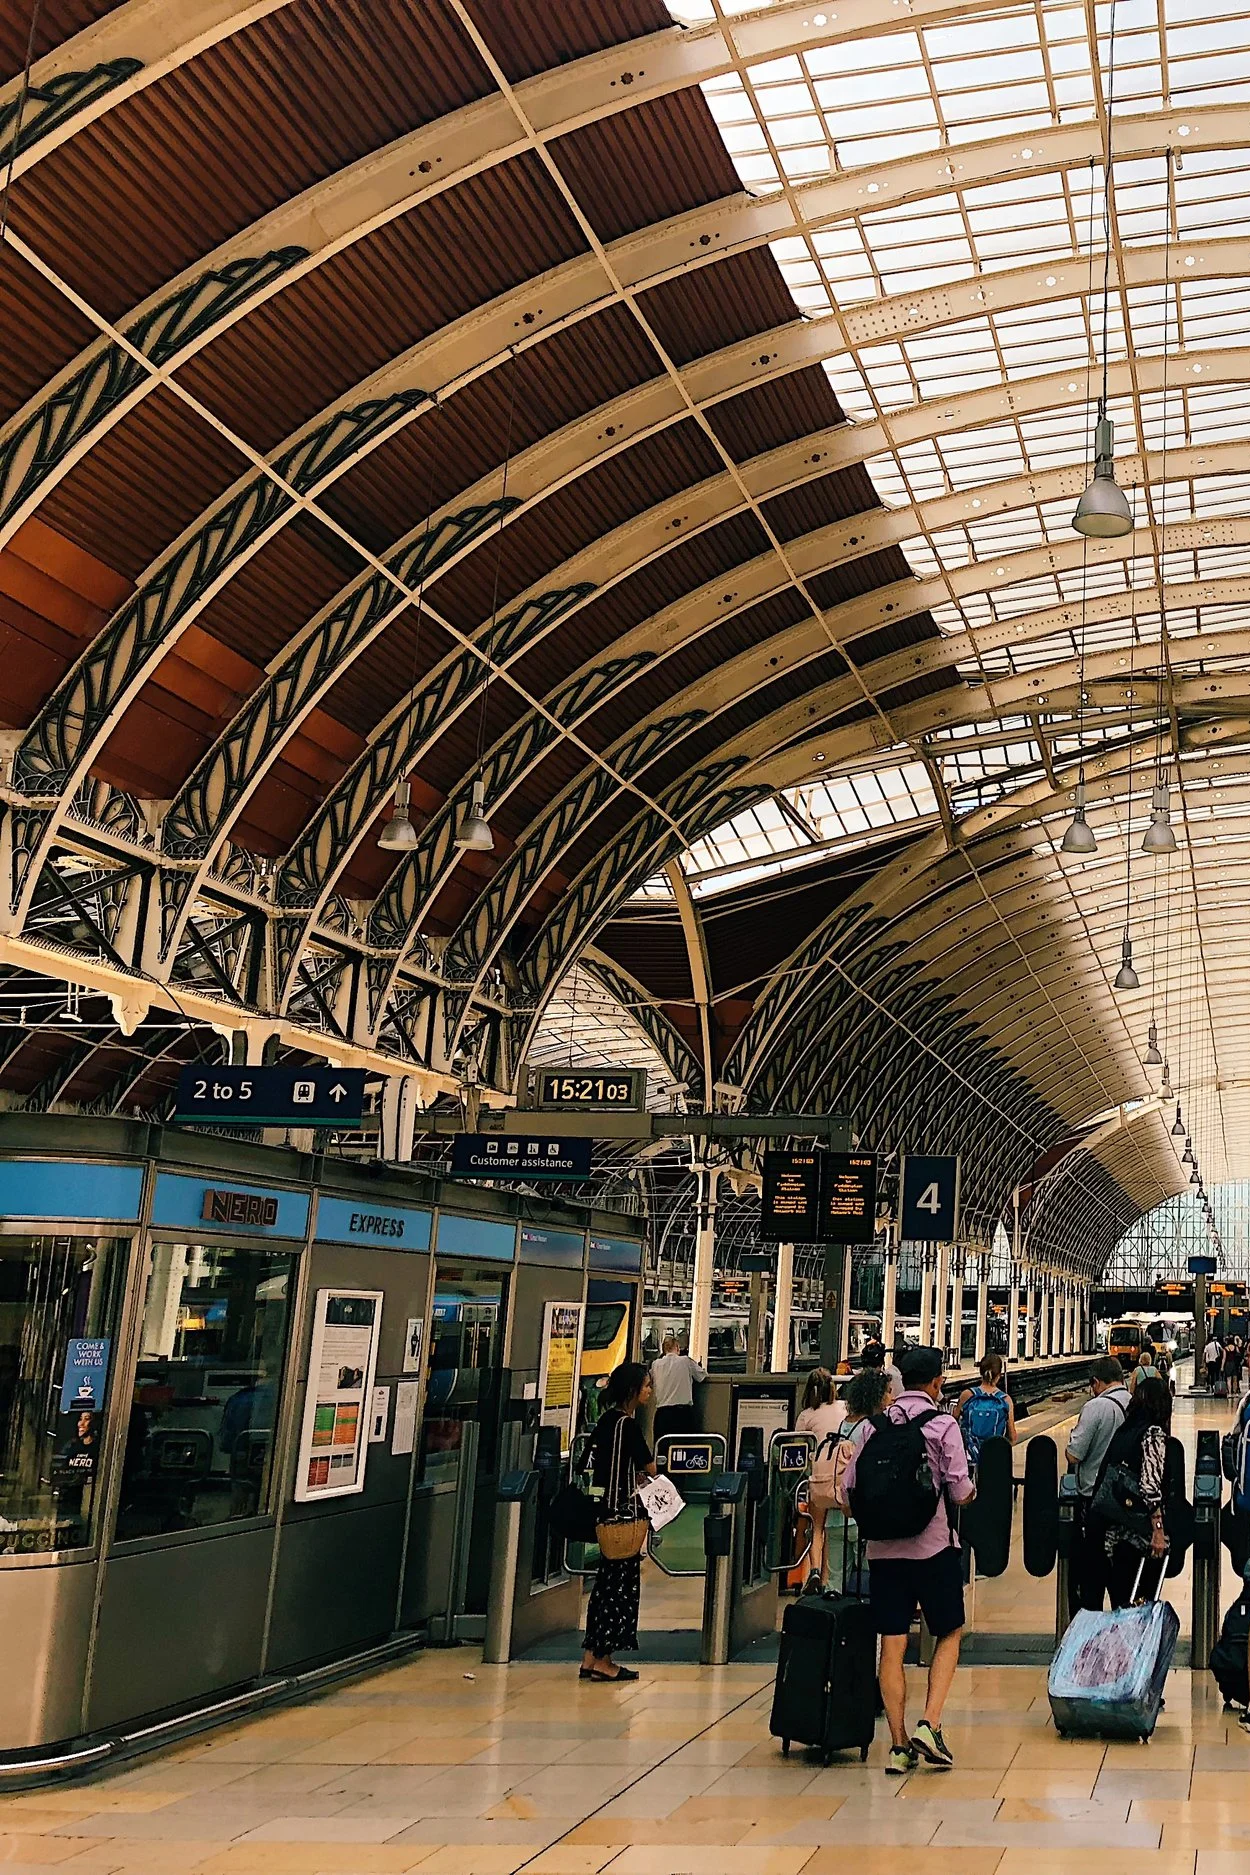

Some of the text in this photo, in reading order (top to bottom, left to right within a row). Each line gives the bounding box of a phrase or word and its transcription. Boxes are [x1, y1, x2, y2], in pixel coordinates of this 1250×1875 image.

[193, 1081, 253, 1100] 2 to 5
[470, 1155, 573, 1168] Customer assistance
[916, 1182, 941, 1214] 4
[204, 1189, 279, 1226] NERO
[350, 1213, 405, 1237] EXPRESS
[76, 1342, 105, 1350] COME &
[78, 1350, 101, 1358] WORK
[73, 1358, 103, 1366] WITH US
[68, 1457, 93, 1468] NERO
